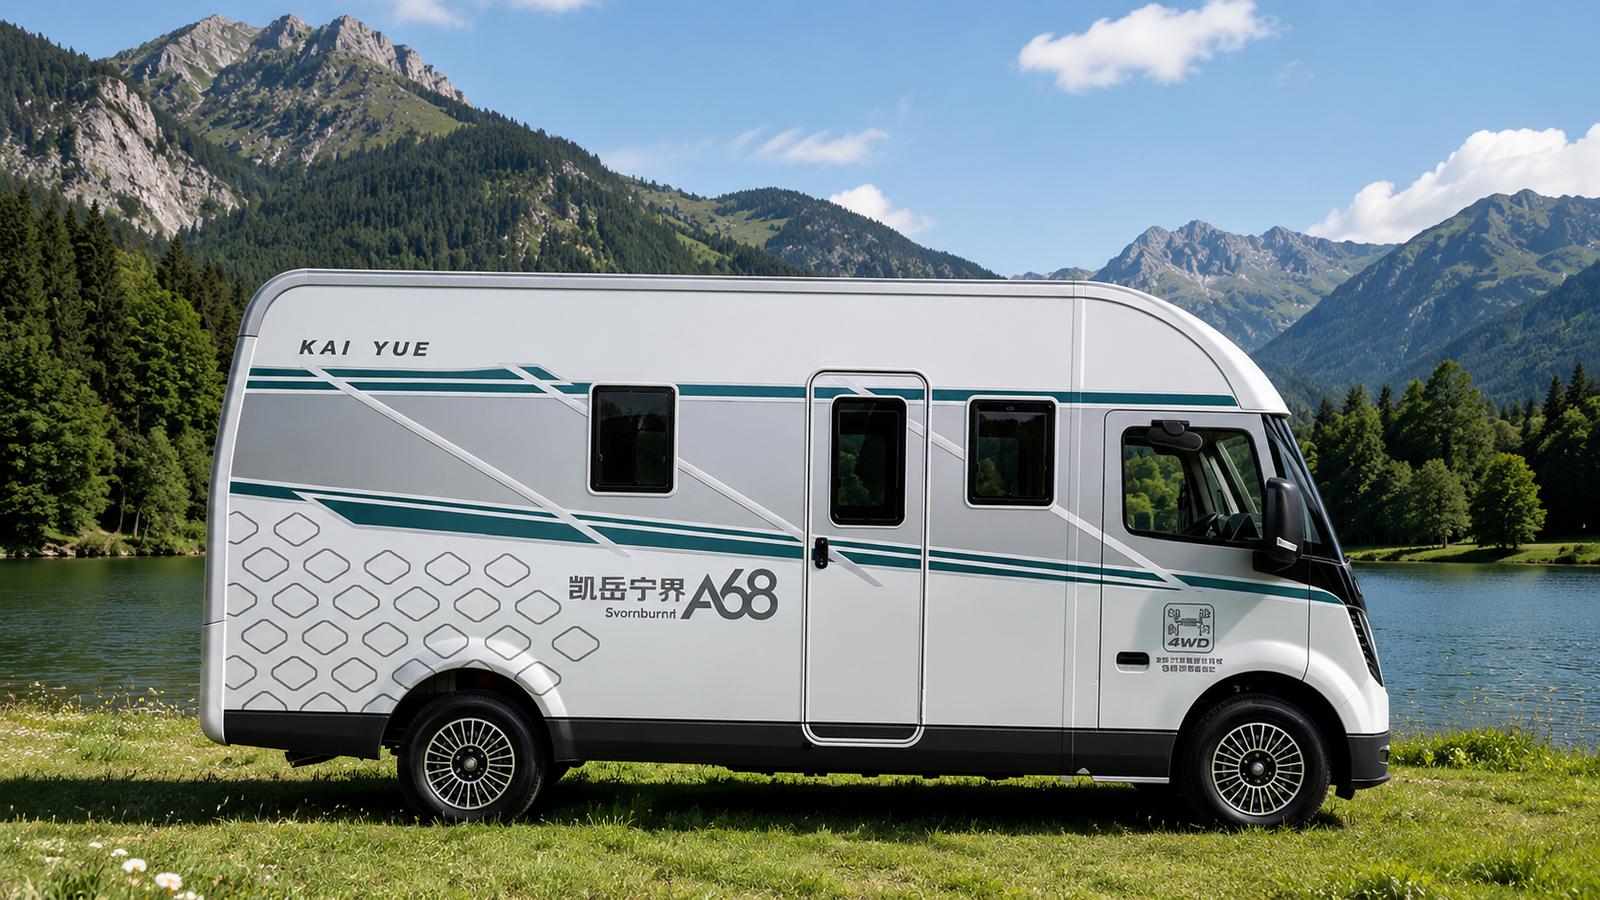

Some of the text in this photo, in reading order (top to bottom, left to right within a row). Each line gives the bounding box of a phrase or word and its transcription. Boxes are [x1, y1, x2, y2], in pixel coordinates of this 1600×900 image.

[298, 339, 430, 357] KAI YUE
[568, 568, 779, 621] 凯岳宁界 A68
[1167, 637, 1210, 648] 4WD
